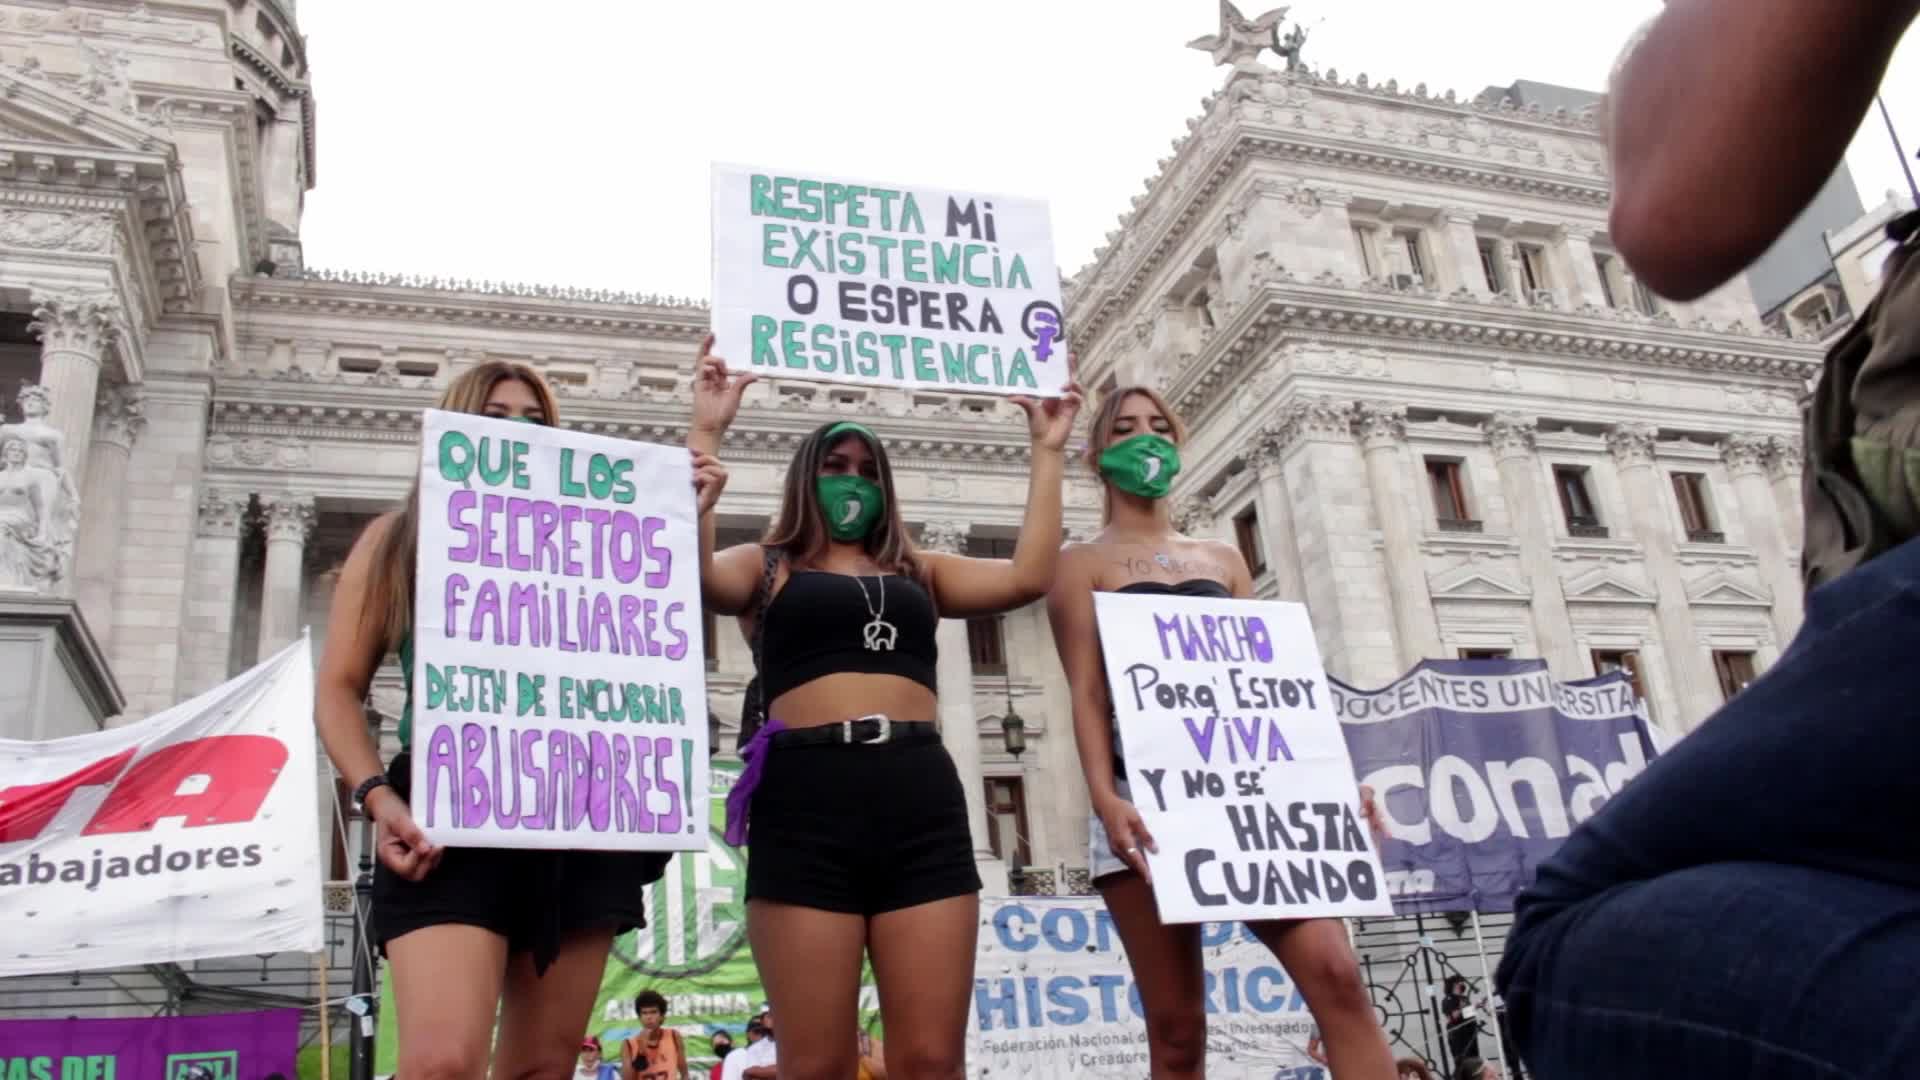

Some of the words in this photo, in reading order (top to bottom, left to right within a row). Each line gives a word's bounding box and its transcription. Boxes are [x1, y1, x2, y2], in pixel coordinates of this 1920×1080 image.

[750, 174, 925, 234] RESPETA
[787, 274, 818, 315] O
[838, 280, 1004, 334] ESPERA
[439, 430, 530, 489] QUE
[559, 447, 637, 503] LOS
[447, 490, 672, 589] SECRETOS
[1153, 613, 1274, 663] MARCHO
[425, 662, 506, 714] DEJEN
[516, 672, 546, 717] DE
[1229, 668, 1316, 710] ESTOY
[1139, 769, 1167, 812] Y
[1182, 769, 1225, 799] NO
[1225, 801, 1369, 852] HASTA
[1184, 848, 1378, 906] CUANDO
[1070, 1032, 1134, 1049] Nacional
[1079, 1052, 1148, 1067] Creadore
